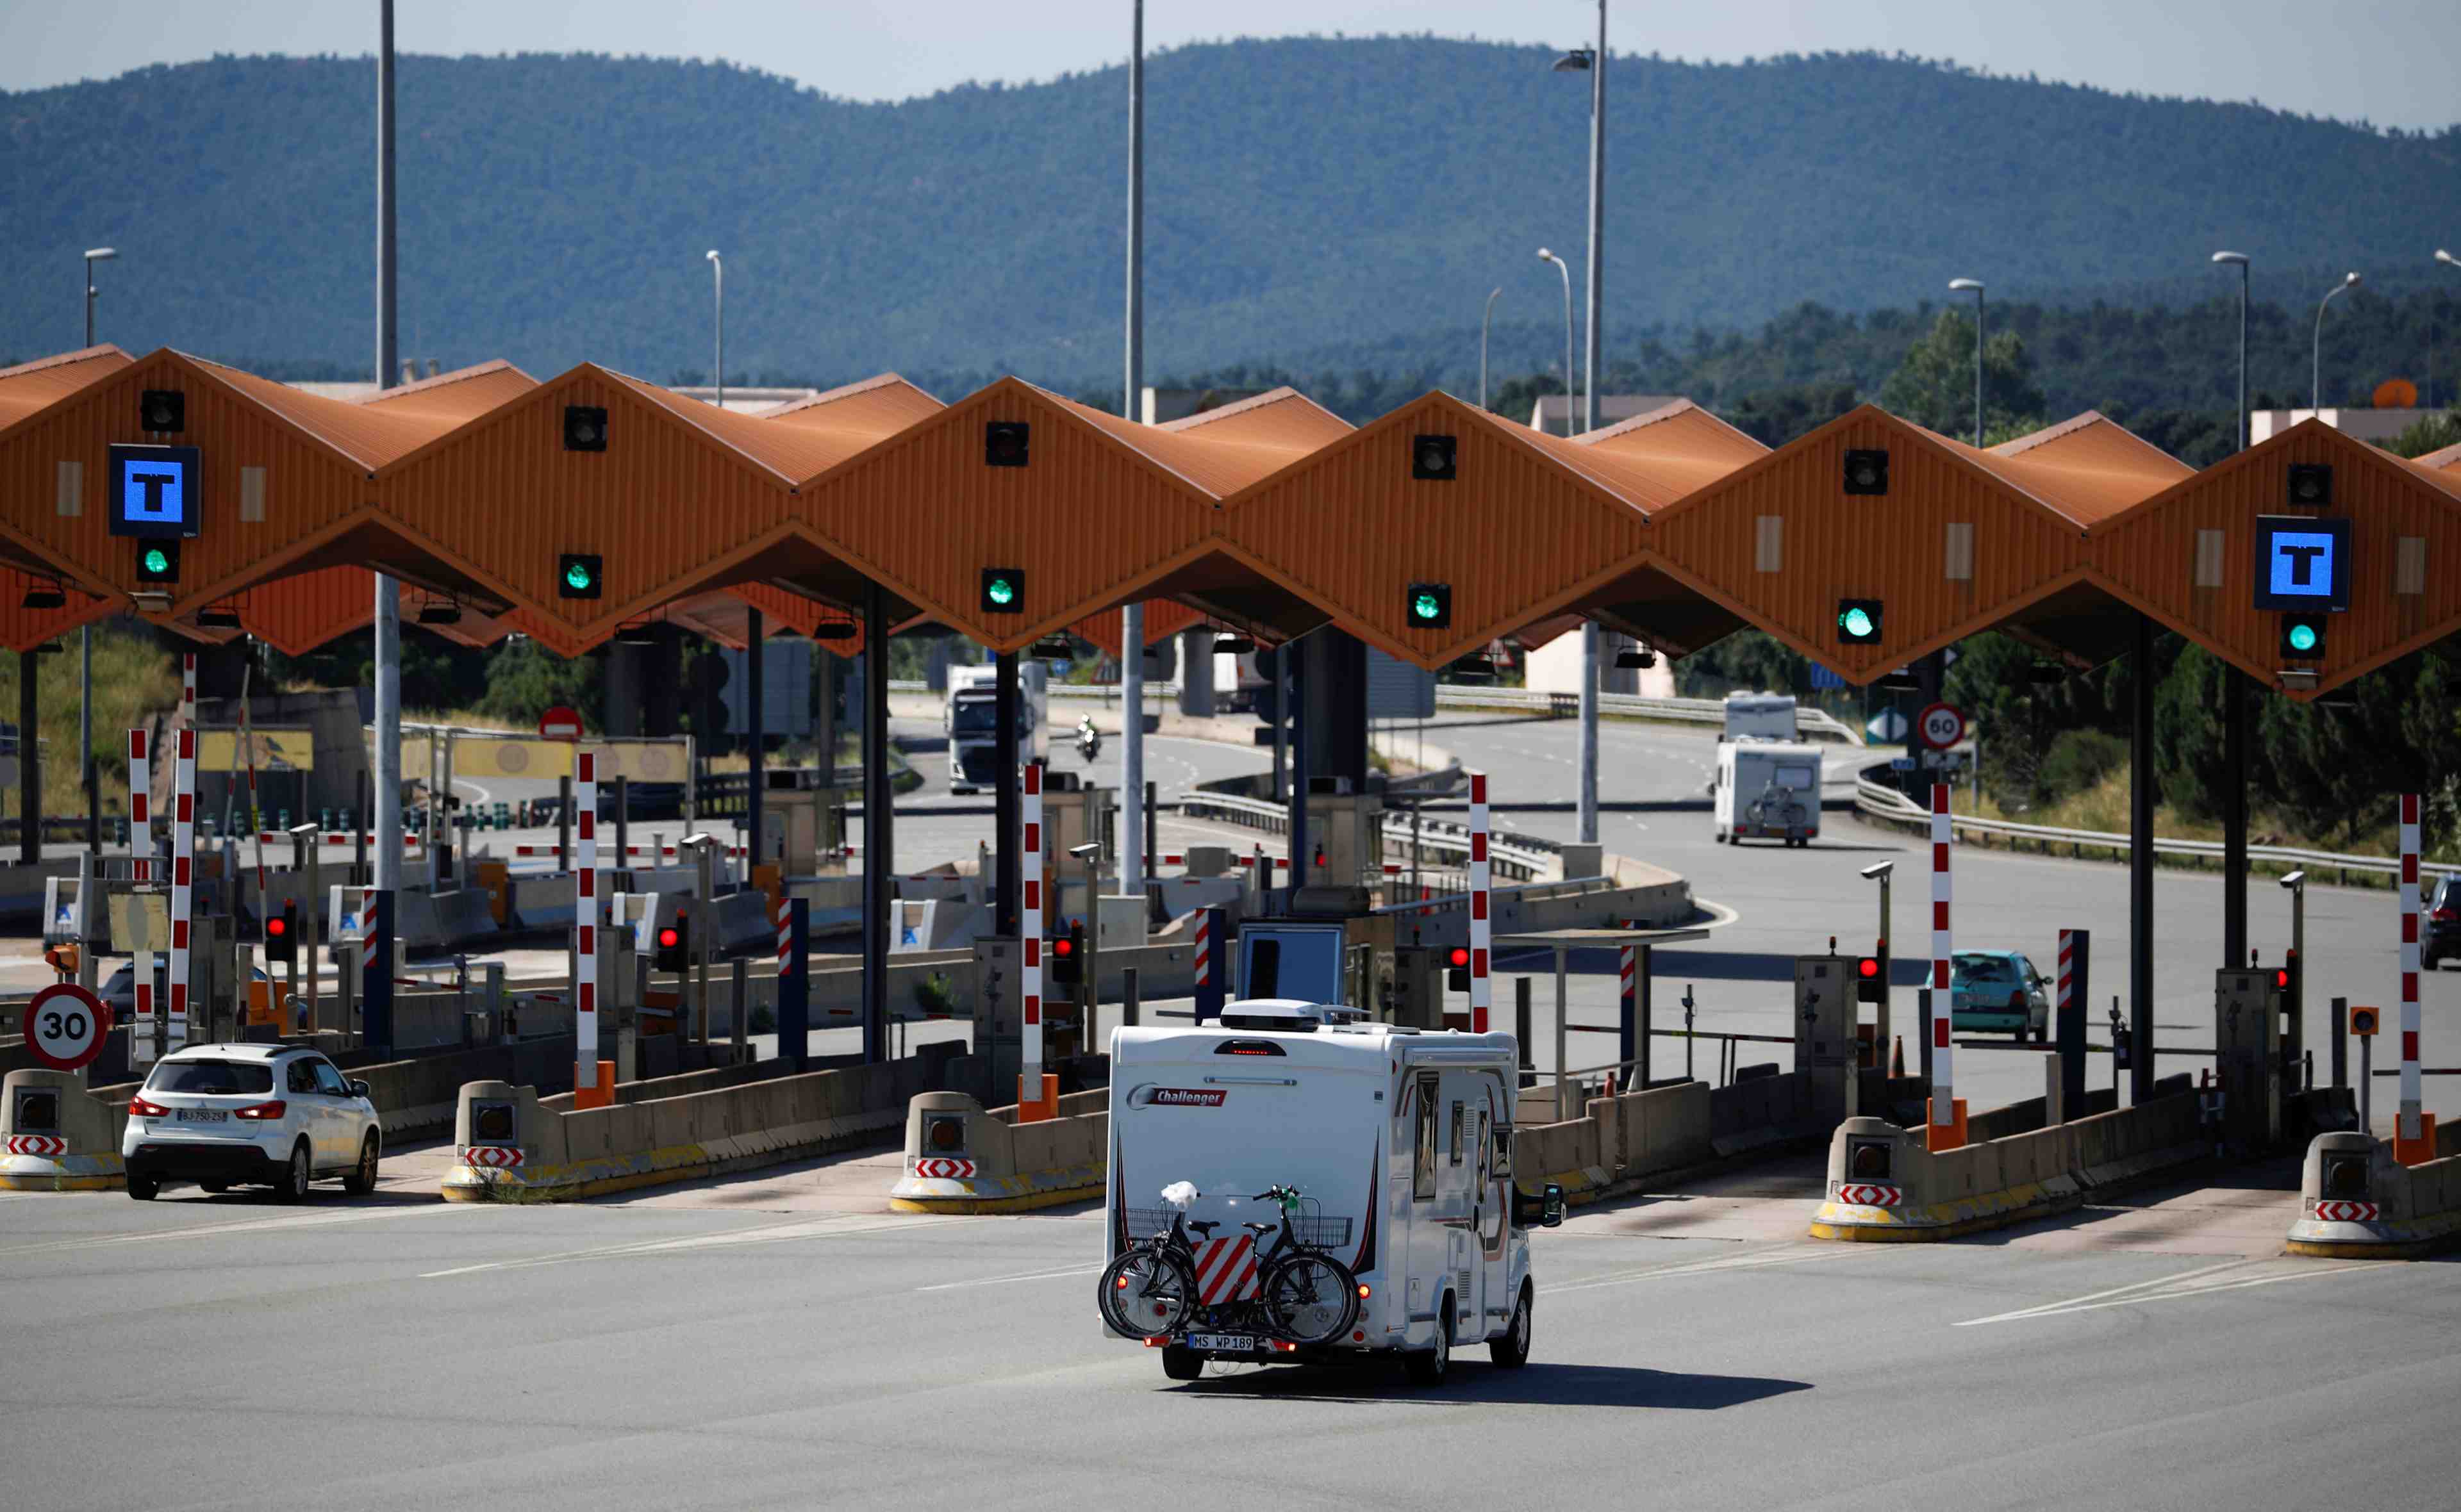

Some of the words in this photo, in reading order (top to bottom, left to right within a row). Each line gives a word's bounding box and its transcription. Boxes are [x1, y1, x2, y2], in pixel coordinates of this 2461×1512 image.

[133, 473, 175, 512] T
[2280, 546, 2324, 586] T
[1930, 718, 1954, 734] 60
[43, 1012, 87, 1040] 30
[1157, 1090, 1221, 1106] Challenger
[1194, 1336, 1209, 1347] MS
[1216, 1337, 1230, 1348] WP
[1232, 1337, 1252, 1349] 189
